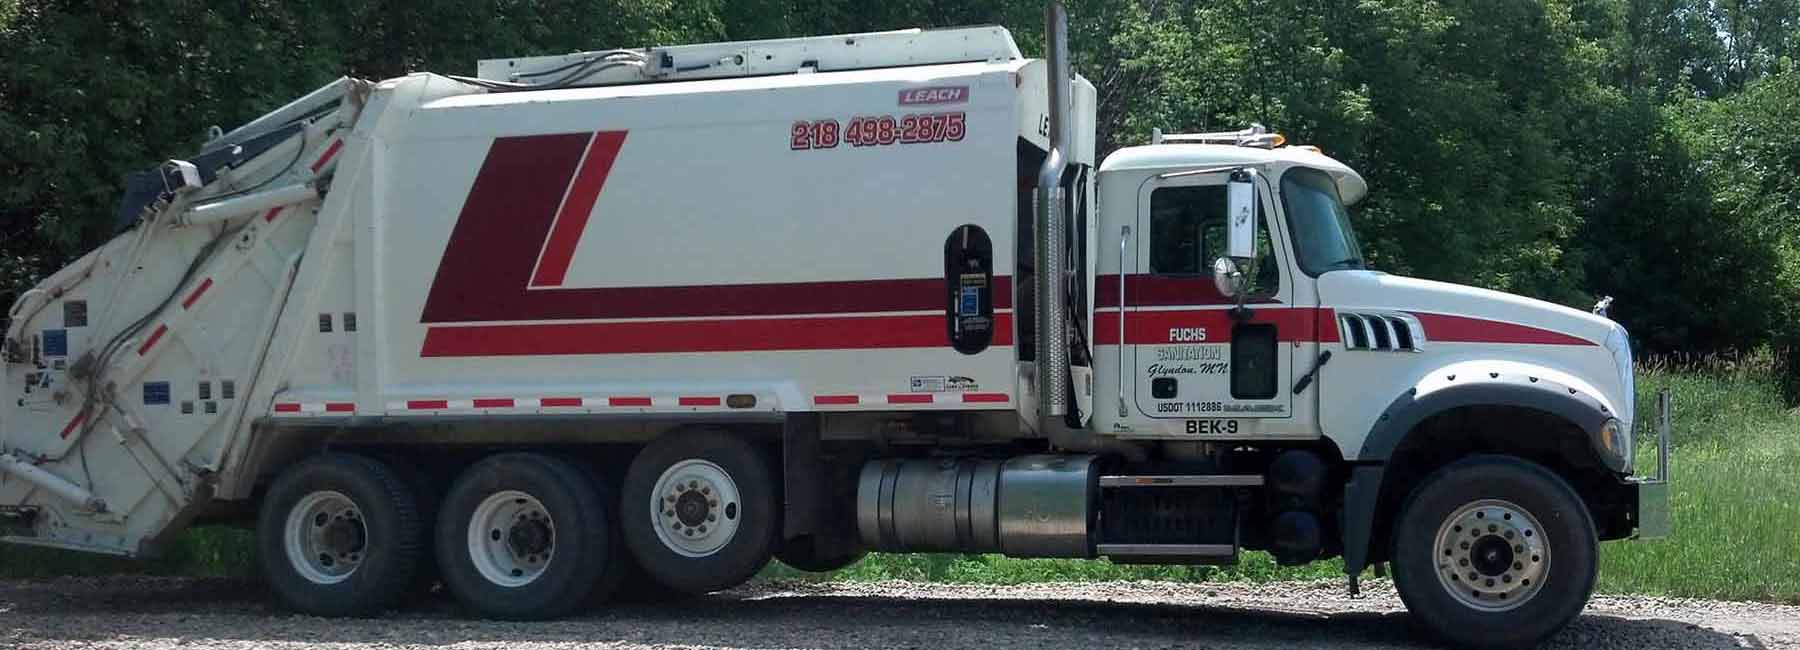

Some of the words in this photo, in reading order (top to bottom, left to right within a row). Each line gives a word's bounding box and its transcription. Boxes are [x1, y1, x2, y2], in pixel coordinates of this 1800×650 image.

[904, 89, 961, 102] LEACH
[791, 119, 839, 150] 218
[844, 112, 966, 146] 498-2875
[1169, 327, 1206, 342] FUCHS
[1157, 345, 1222, 361] SANITATION
[1200, 362, 1229, 374] MN
[1157, 402, 1184, 413] USDOT
[1186, 420, 1239, 434] BEK-9
